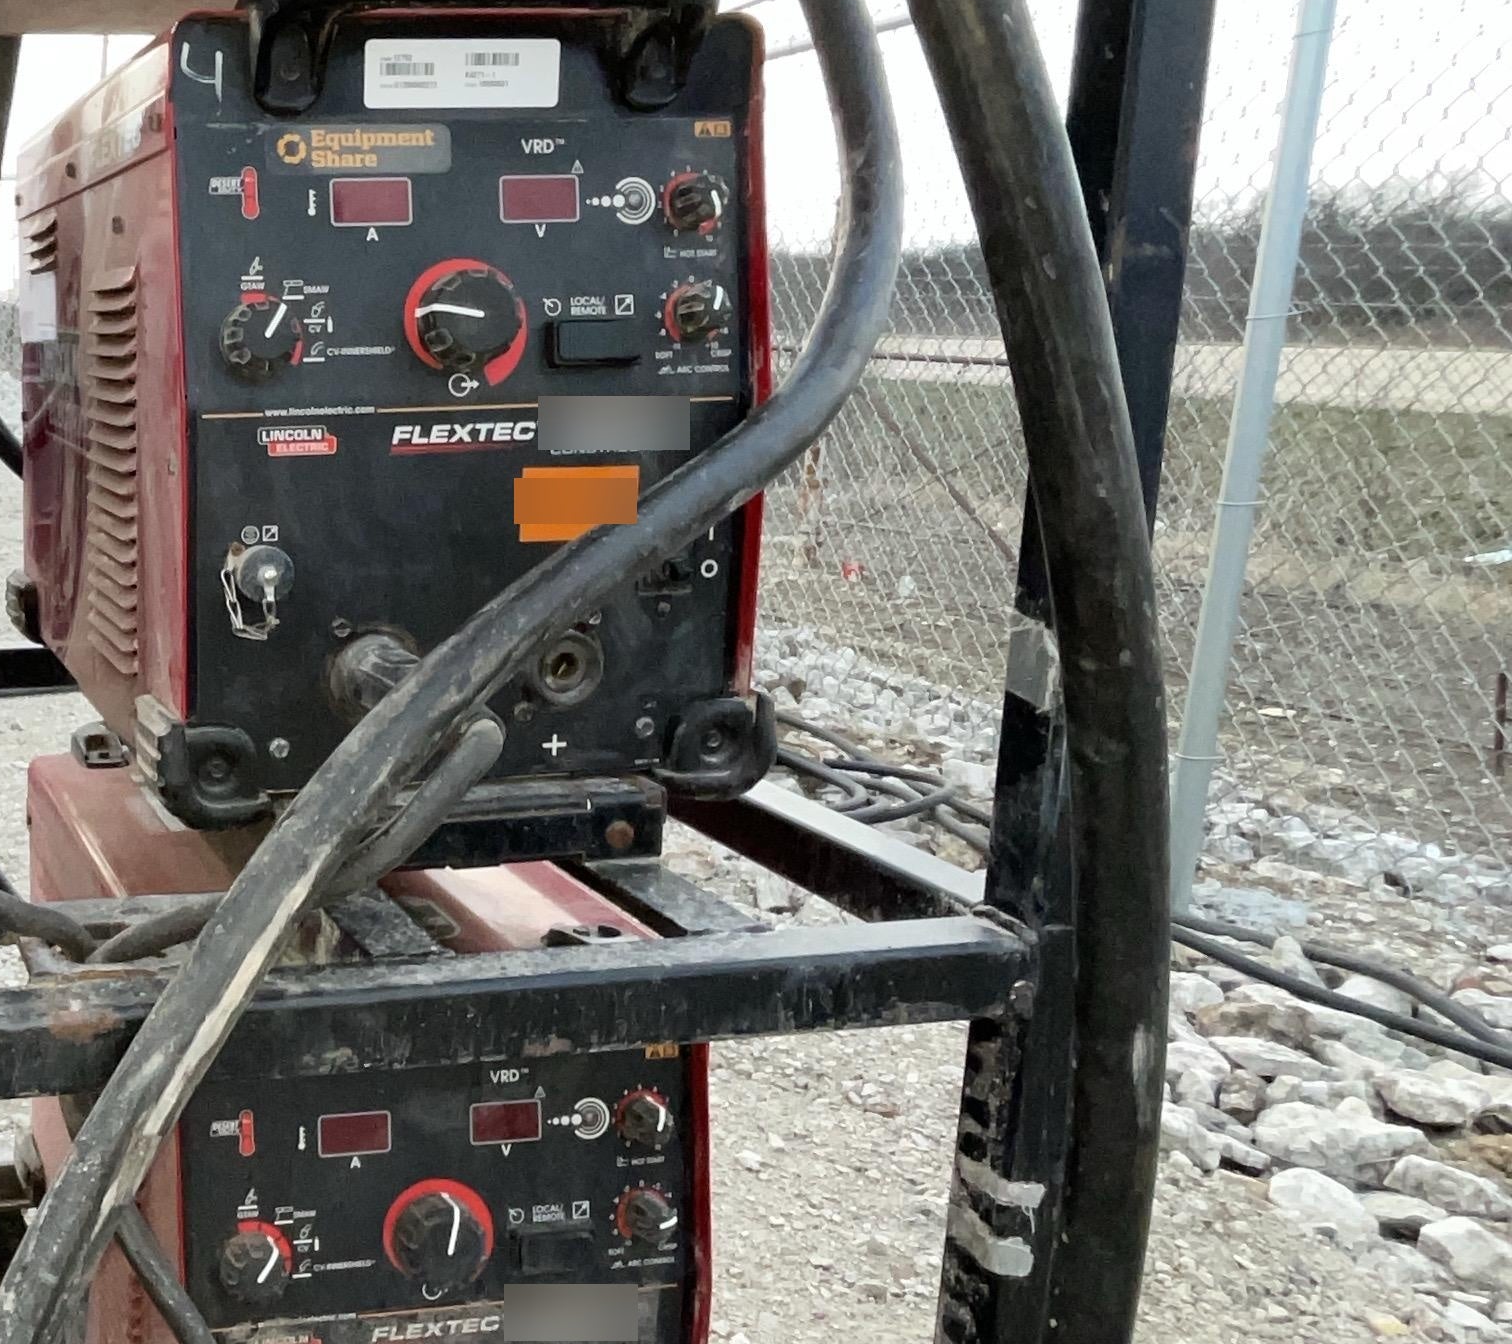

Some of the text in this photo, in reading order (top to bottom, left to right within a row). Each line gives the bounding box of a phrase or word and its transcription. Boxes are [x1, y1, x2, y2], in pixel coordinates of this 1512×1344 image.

[180, 41, 224, 103] 4
[311, 128, 435, 150] Equipment
[311, 151, 377, 168] Share
[366, 227, 378, 241] A
[535, 224, 546, 237] V
[261, 428, 323, 442] LINCOLN
[276, 441, 329, 453] ELECTRIC
[501, 1144, 512, 1156] V
[350, 1156, 361, 1168] A
[372, 1316, 500, 1344] FLEXTEC
